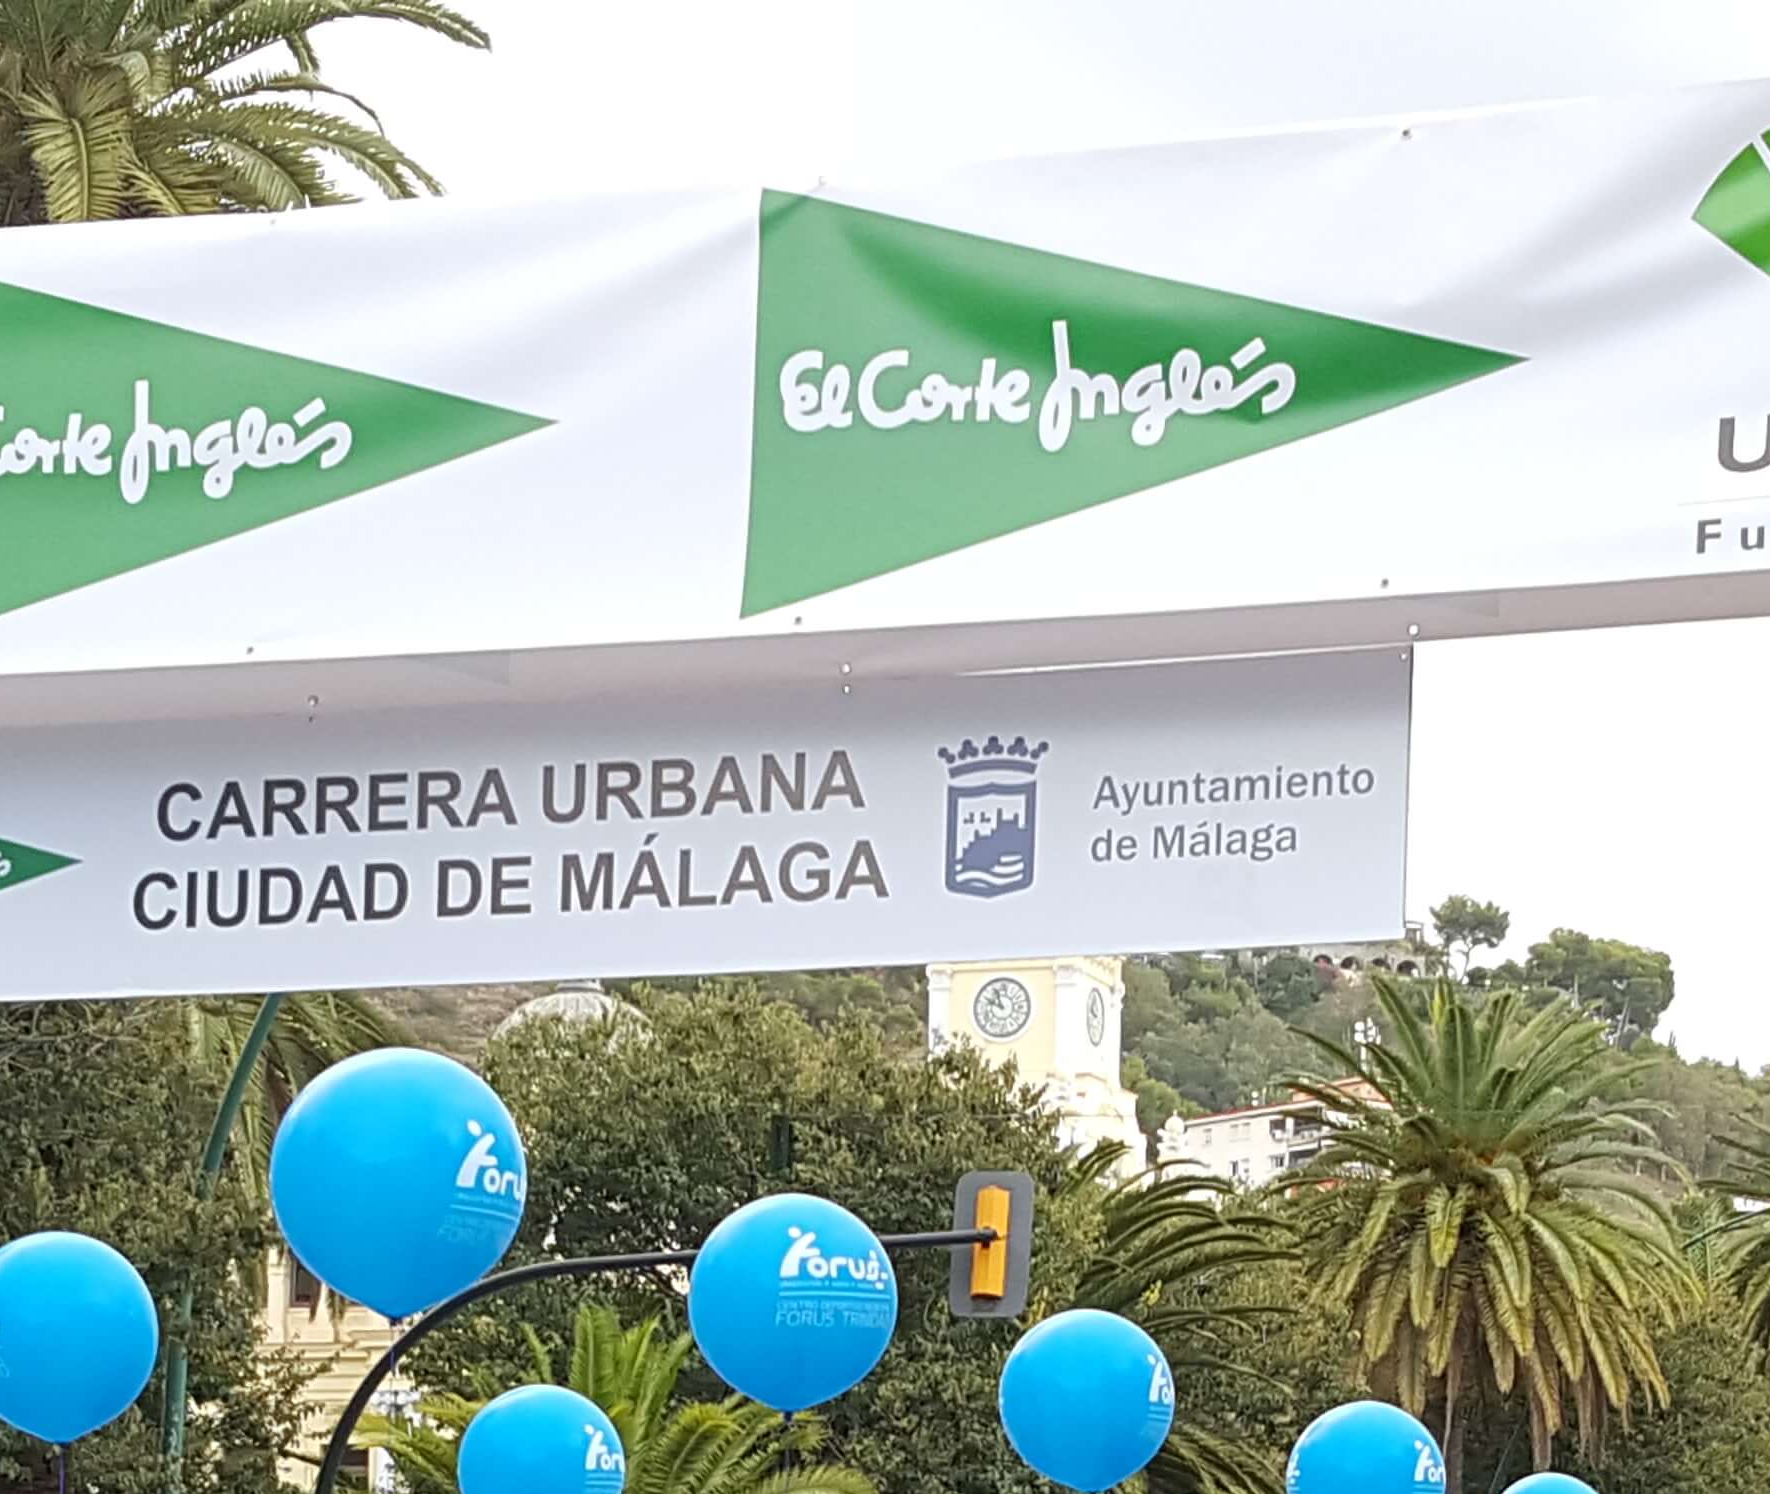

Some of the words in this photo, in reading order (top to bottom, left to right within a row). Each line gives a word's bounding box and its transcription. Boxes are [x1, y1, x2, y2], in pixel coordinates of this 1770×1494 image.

[779, 350, 852, 433] El
[858, 350, 1030, 429] Corte
[1038, 319, 1296, 452] Inglés
[119, 379, 352, 505] Inglés
[155, 767, 519, 842] CARRERA
[541, 749, 866, 826] URBANA
[1093, 764, 1375, 815] Ayuntamiento
[133, 863, 409, 932] CIUDAD
[436, 856, 533, 919] DE
[560, 834, 890, 912] MÁLAGA
[1090, 825, 1138, 863] de
[1152, 817, 1299, 862] Málaga
